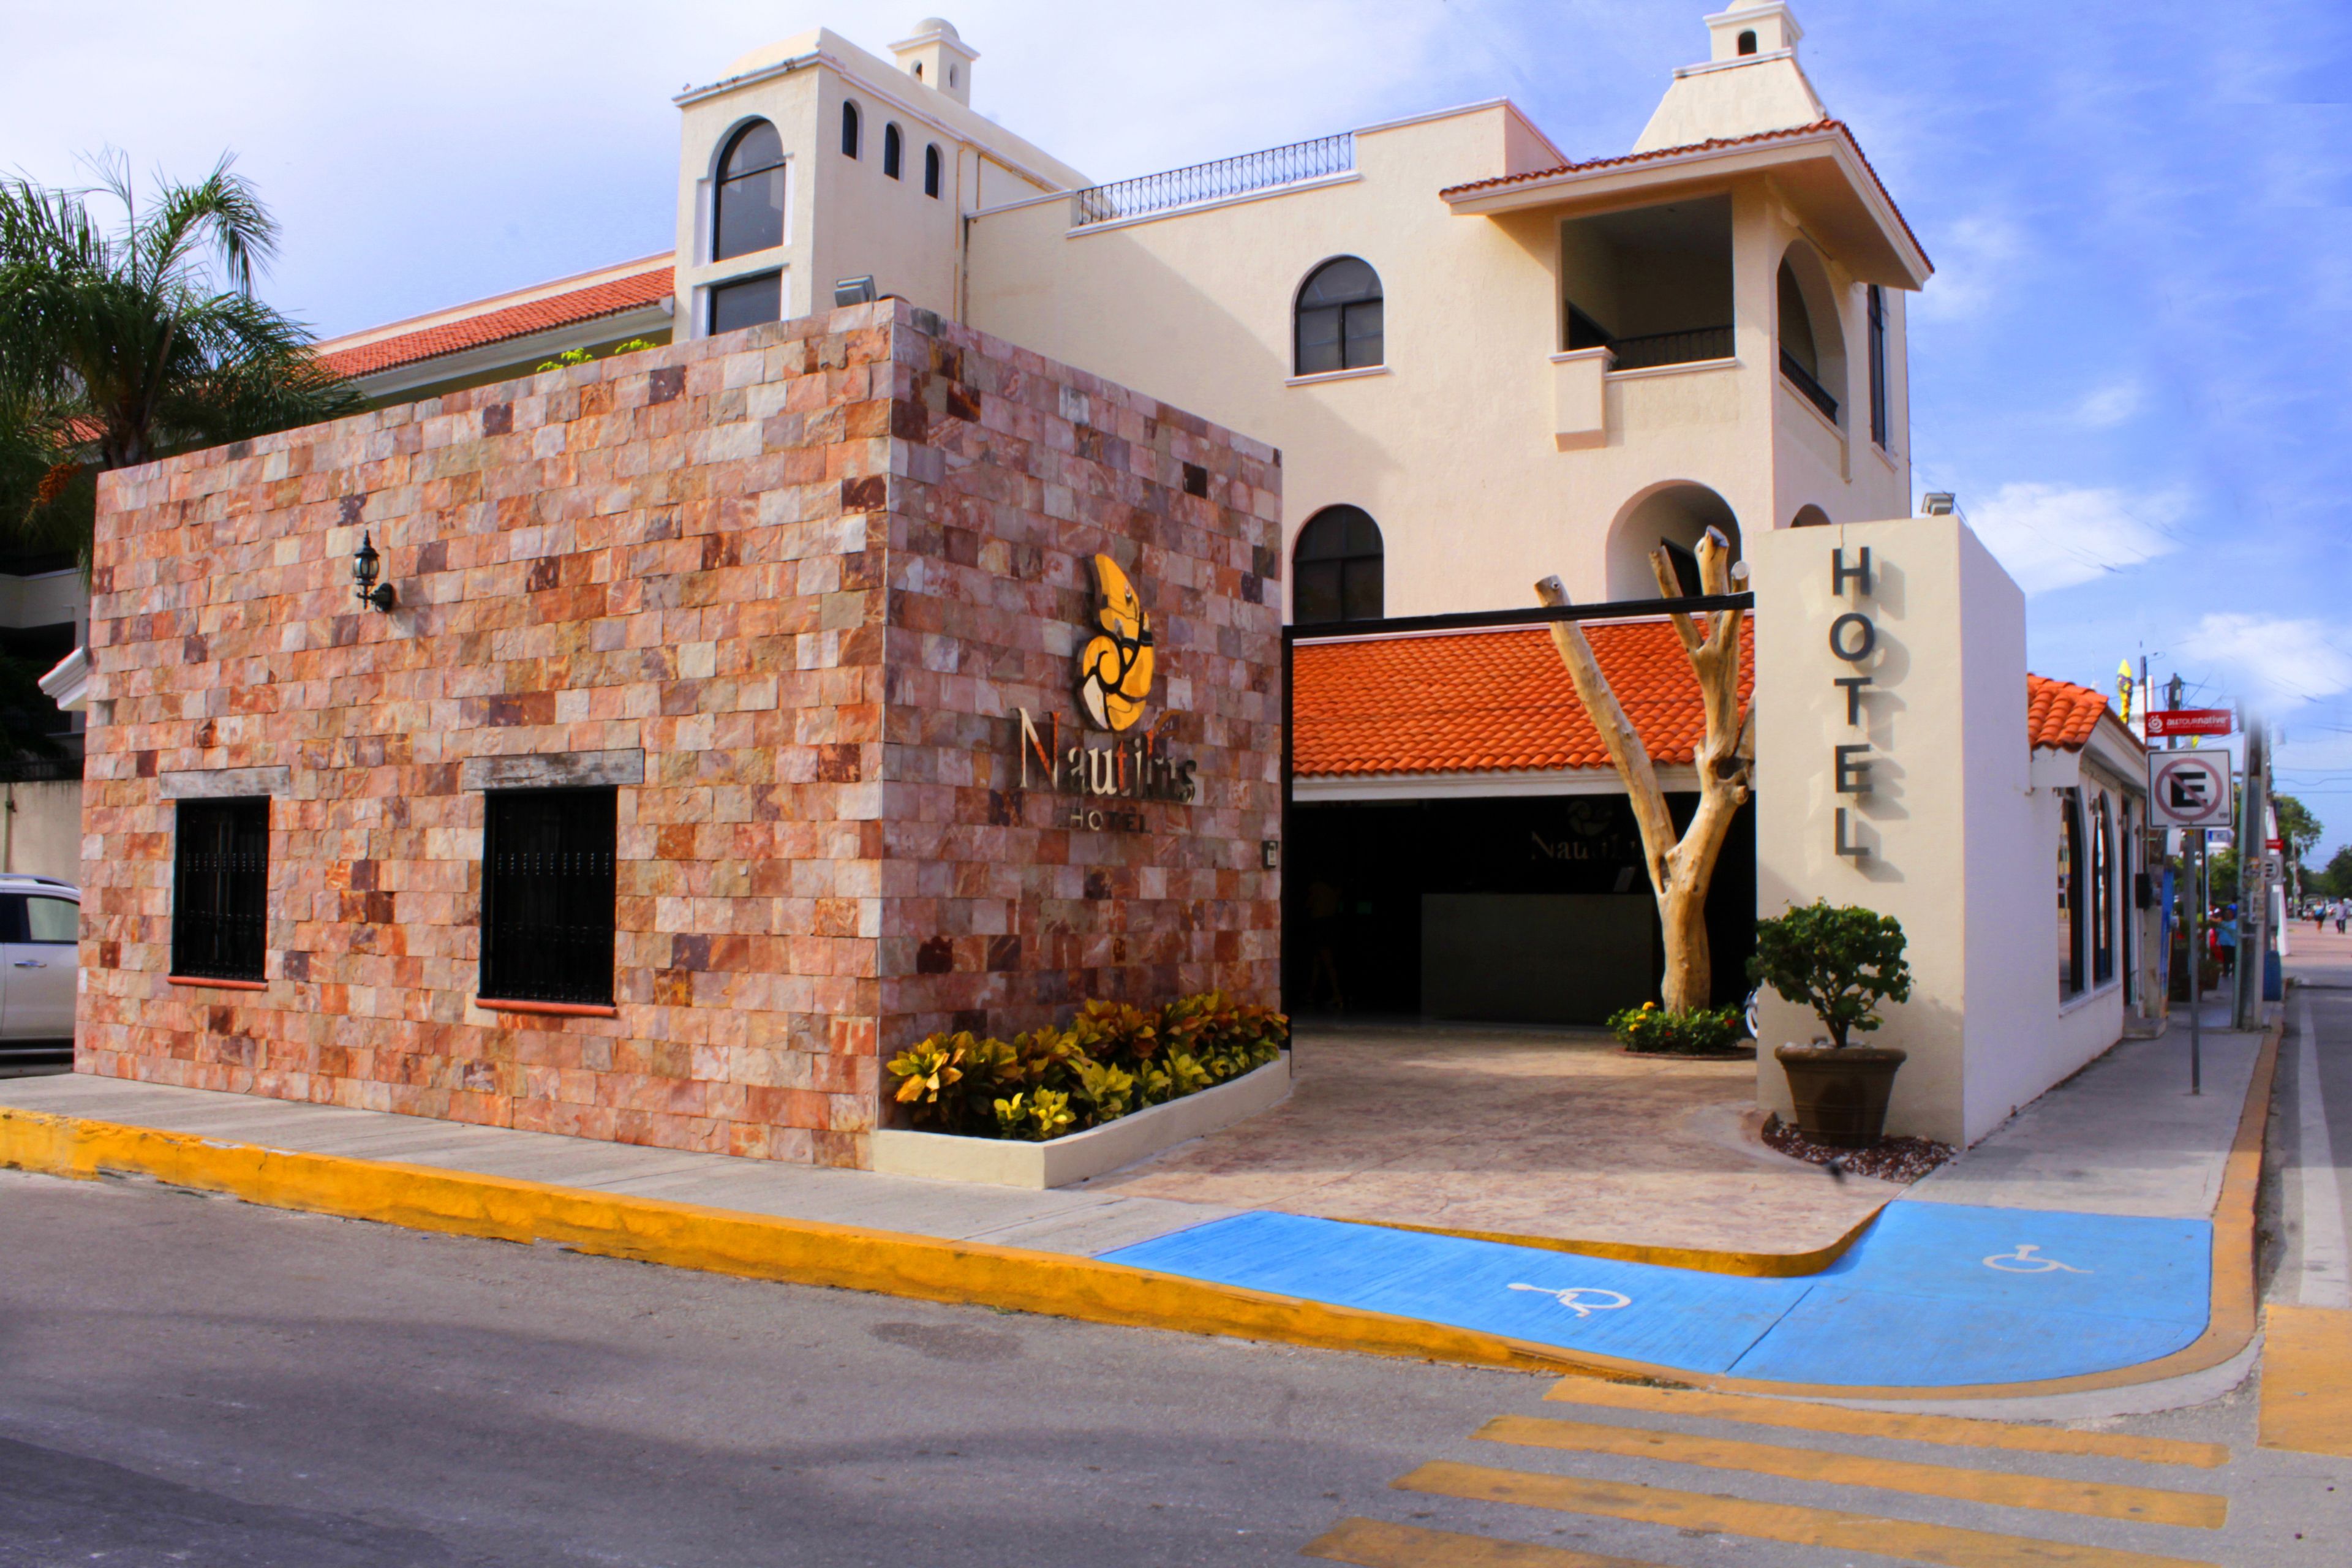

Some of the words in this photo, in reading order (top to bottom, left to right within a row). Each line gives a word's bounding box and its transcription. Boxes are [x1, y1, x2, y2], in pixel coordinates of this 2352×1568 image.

[1829, 546, 1875, 856] HOTEL
[1011, 707, 1197, 804] Nautilus
[1070, 807, 1152, 834] HOTEL
[2170, 772, 2208, 807] E
